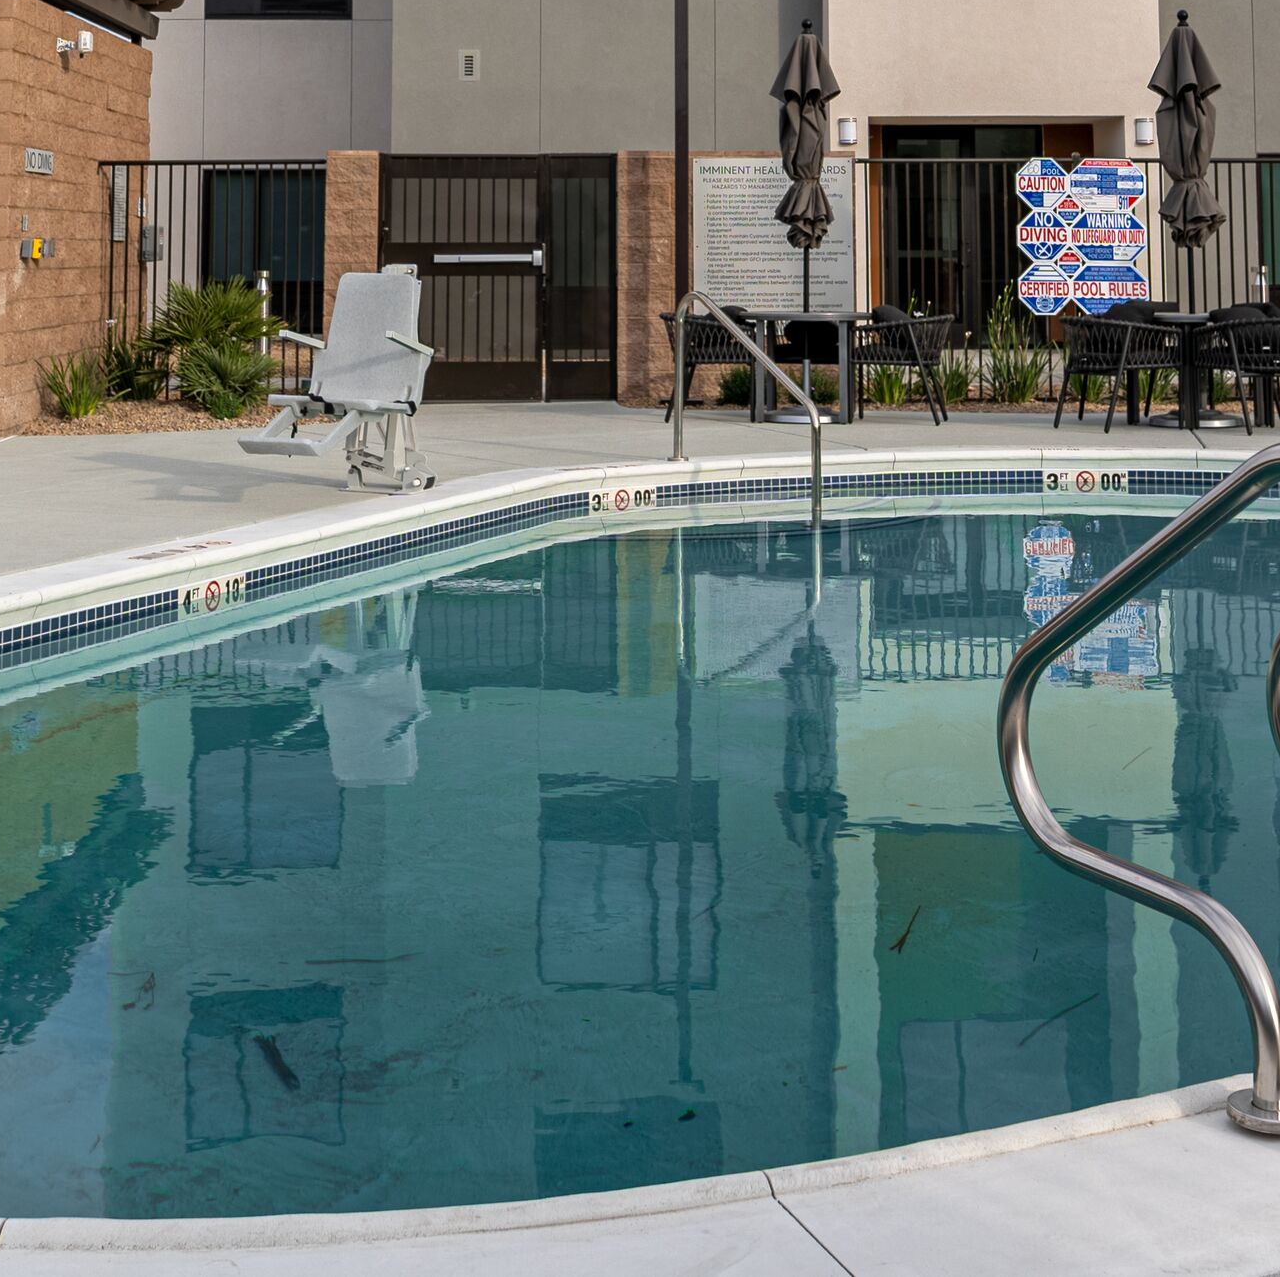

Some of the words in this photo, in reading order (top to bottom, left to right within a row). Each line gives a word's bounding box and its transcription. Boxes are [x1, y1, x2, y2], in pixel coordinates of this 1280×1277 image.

[27, 152, 36, 168] NO
[700, 166, 751, 174] IMMINENT
[754, 166, 785, 174] HEALT
[821, 166, 846, 174] ARDS
[1019, 177, 1064, 190] CAUTION
[1119, 196, 1128, 209] 911
[1035, 212, 1053, 226] NO
[1086, 214, 1131, 228] WARNING
[1020, 228, 1067, 242] DIVING
[1072, 230, 1080, 243] NO
[1083, 230, 1116, 243] LIFEGUARD
[1118, 231, 1126, 243] ON
[1129, 231, 1145, 244] DUTY
[1020, 282, 1069, 295] CERTIFIED
[1073, 282, 1105, 296] POOL
[1109, 283, 1146, 296] RULES
[1046, 473, 1058, 490] 3
[592, 494, 601, 511] 3
[192, 587, 200, 598] FT
